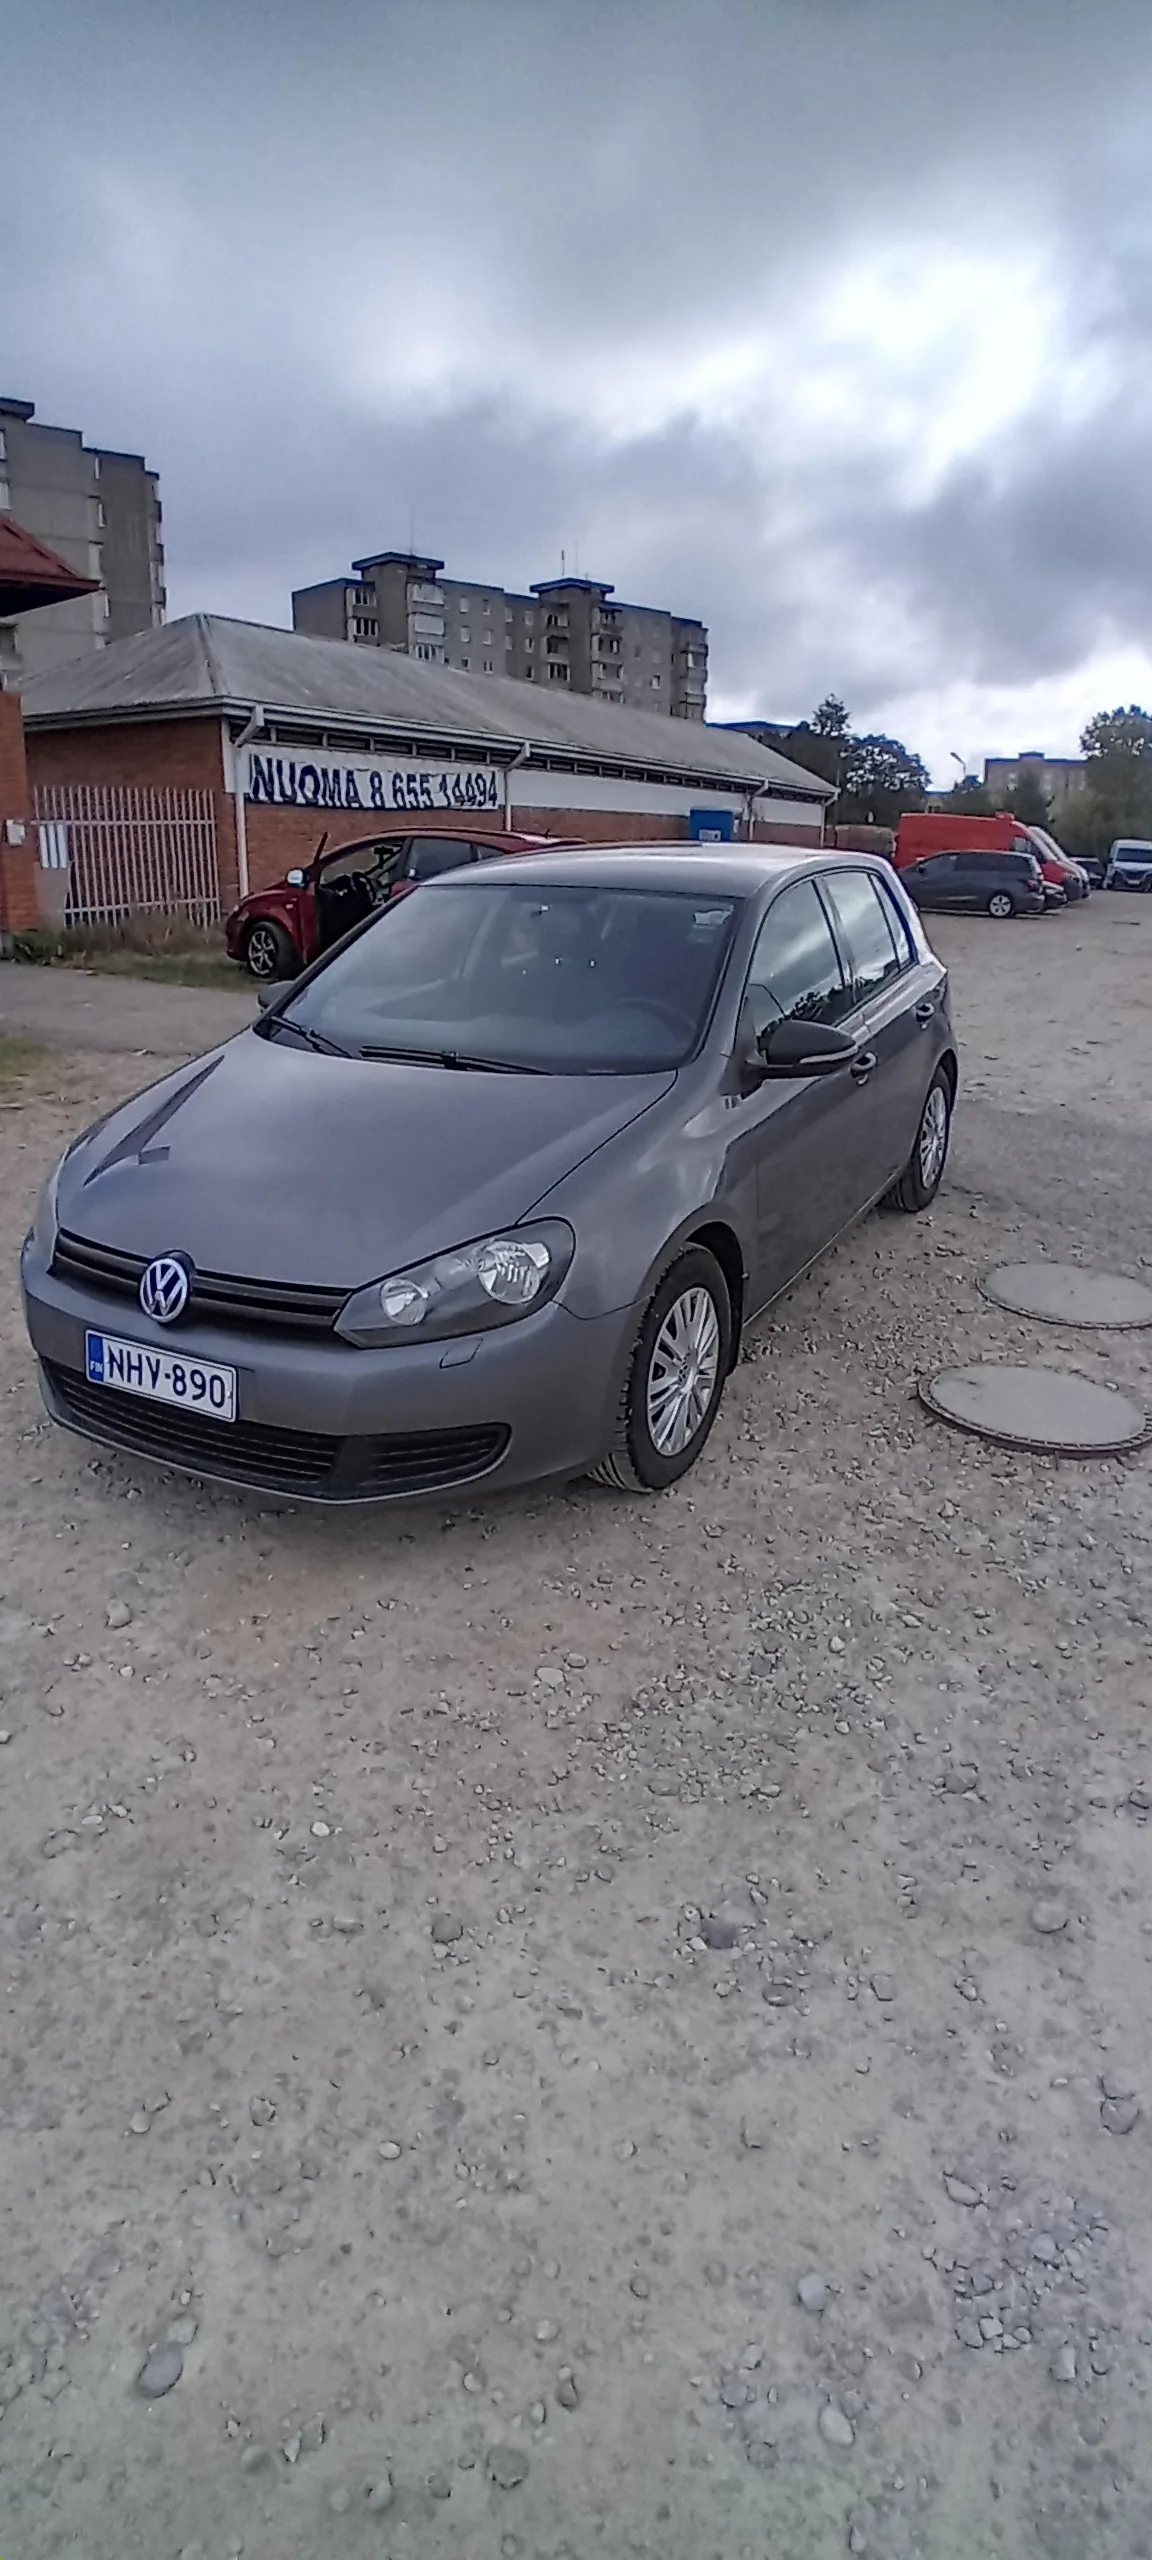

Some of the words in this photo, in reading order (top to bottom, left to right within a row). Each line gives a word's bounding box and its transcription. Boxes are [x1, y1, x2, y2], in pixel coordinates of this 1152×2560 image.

[252, 754, 361, 806] NUOMA
[370, 770, 384, 808] 8
[392, 771, 433, 808] 655
[439, 771, 498, 808] 14494
[142, 1261, 186, 1319] VW
[108, 1345, 225, 1407] NHV-890
